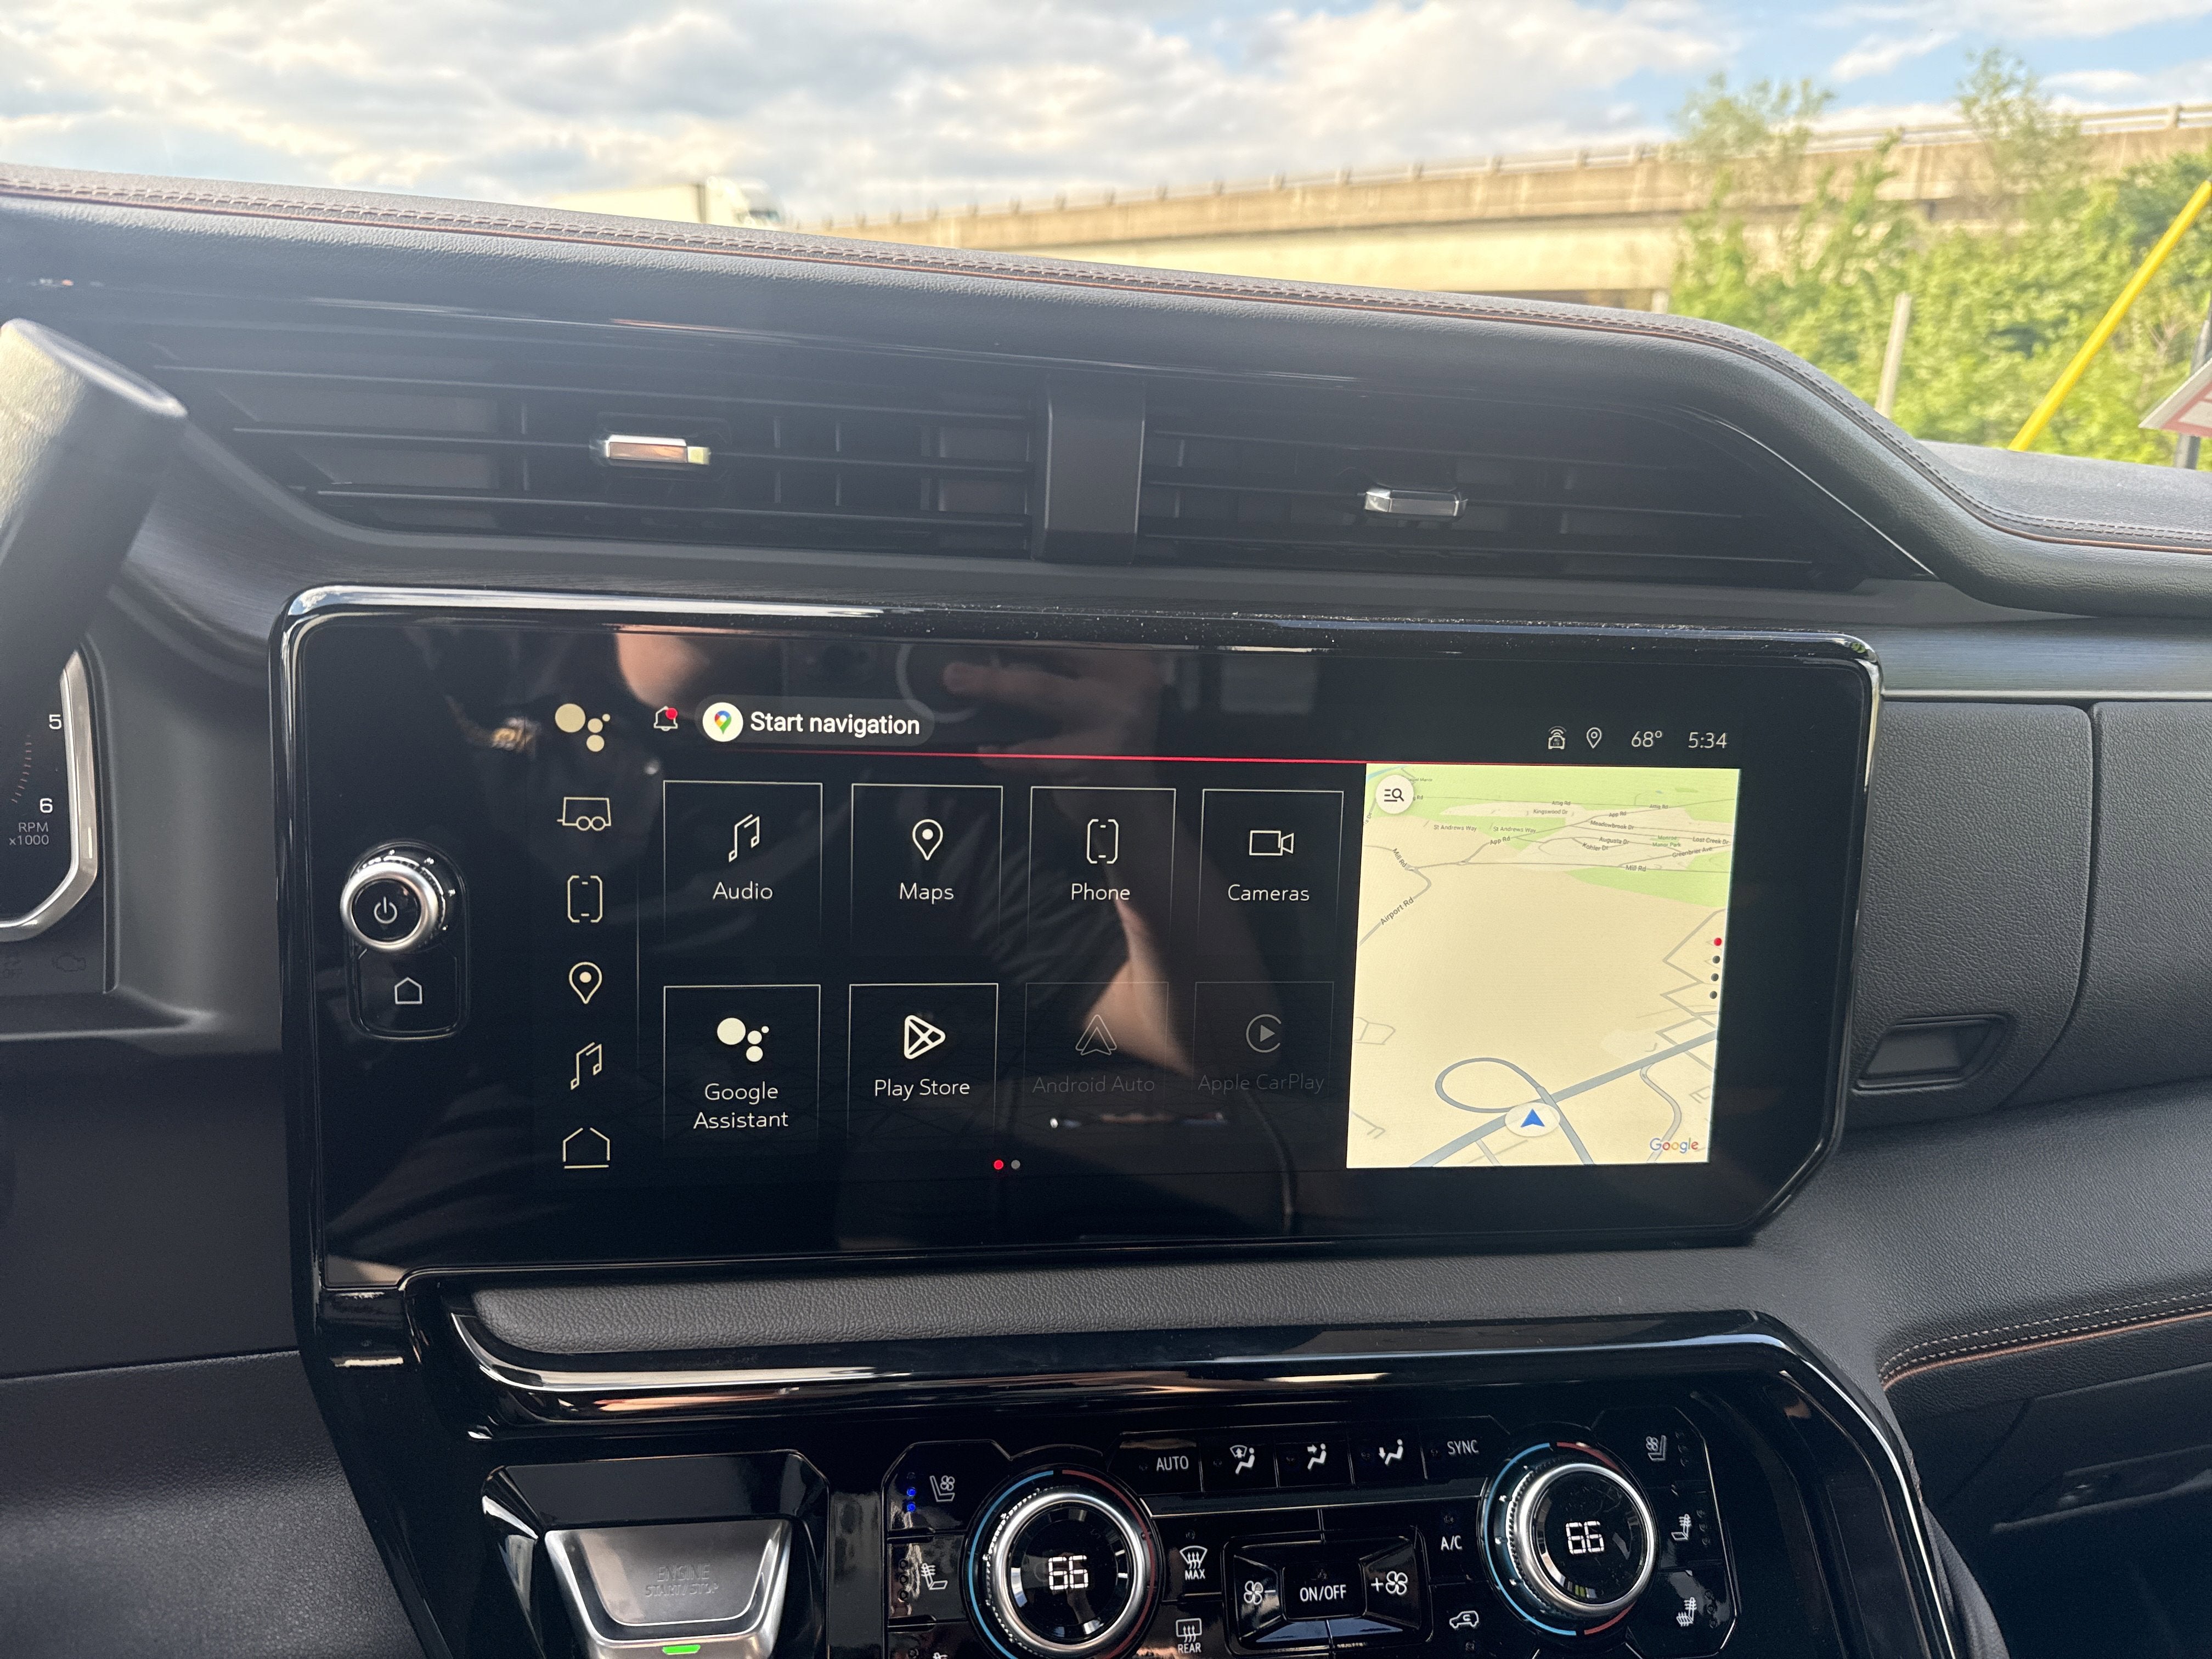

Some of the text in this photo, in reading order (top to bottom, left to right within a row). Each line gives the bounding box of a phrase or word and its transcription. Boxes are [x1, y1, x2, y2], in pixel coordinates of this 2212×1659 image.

[49, 714, 62, 730] 5
[751, 711, 920, 738] Start navigation
[1688, 731, 1728, 749] 5:34
[40, 798, 53, 814] 6
[19, 823, 49, 832] RPM
[1590, 820, 1627, 830] Meadowbrook
[9, 834, 49, 845] x1000
[1392, 848, 1408, 868] Mill Rd
[1672, 848, 1701, 858] Greenbrier
[713, 881, 773, 900] Audio
[900, 883, 955, 905] Maps
[1070, 883, 1131, 901] Phone
[1228, 884, 1310, 902] Cameras
[1380, 896, 1414, 926] Airport Rd
[875, 1078, 970, 1101] Play Store
[1032, 1076, 1155, 1094] Android Auto
[1198, 1073, 1325, 1094] Apple CarPlay
[704, 1081, 778, 1105] Google
[693, 1111, 789, 1130] Assistant
[1650, 1137, 1699, 1153] Google
[1447, 1440, 1479, 1455] SYNC
[1156, 1456, 1189, 1472] AUTO
[1441, 1535, 1463, 1551] A/C
[1565, 1520, 1605, 1555] 66
[657, 1564, 710, 1582] ENGINE
[1048, 1554, 1088, 1590] 66
[1184, 1568, 1206, 1580] MAX
[1300, 1584, 1347, 1602] ON/OFF
[1177, 1642, 1202, 1654] REAR
